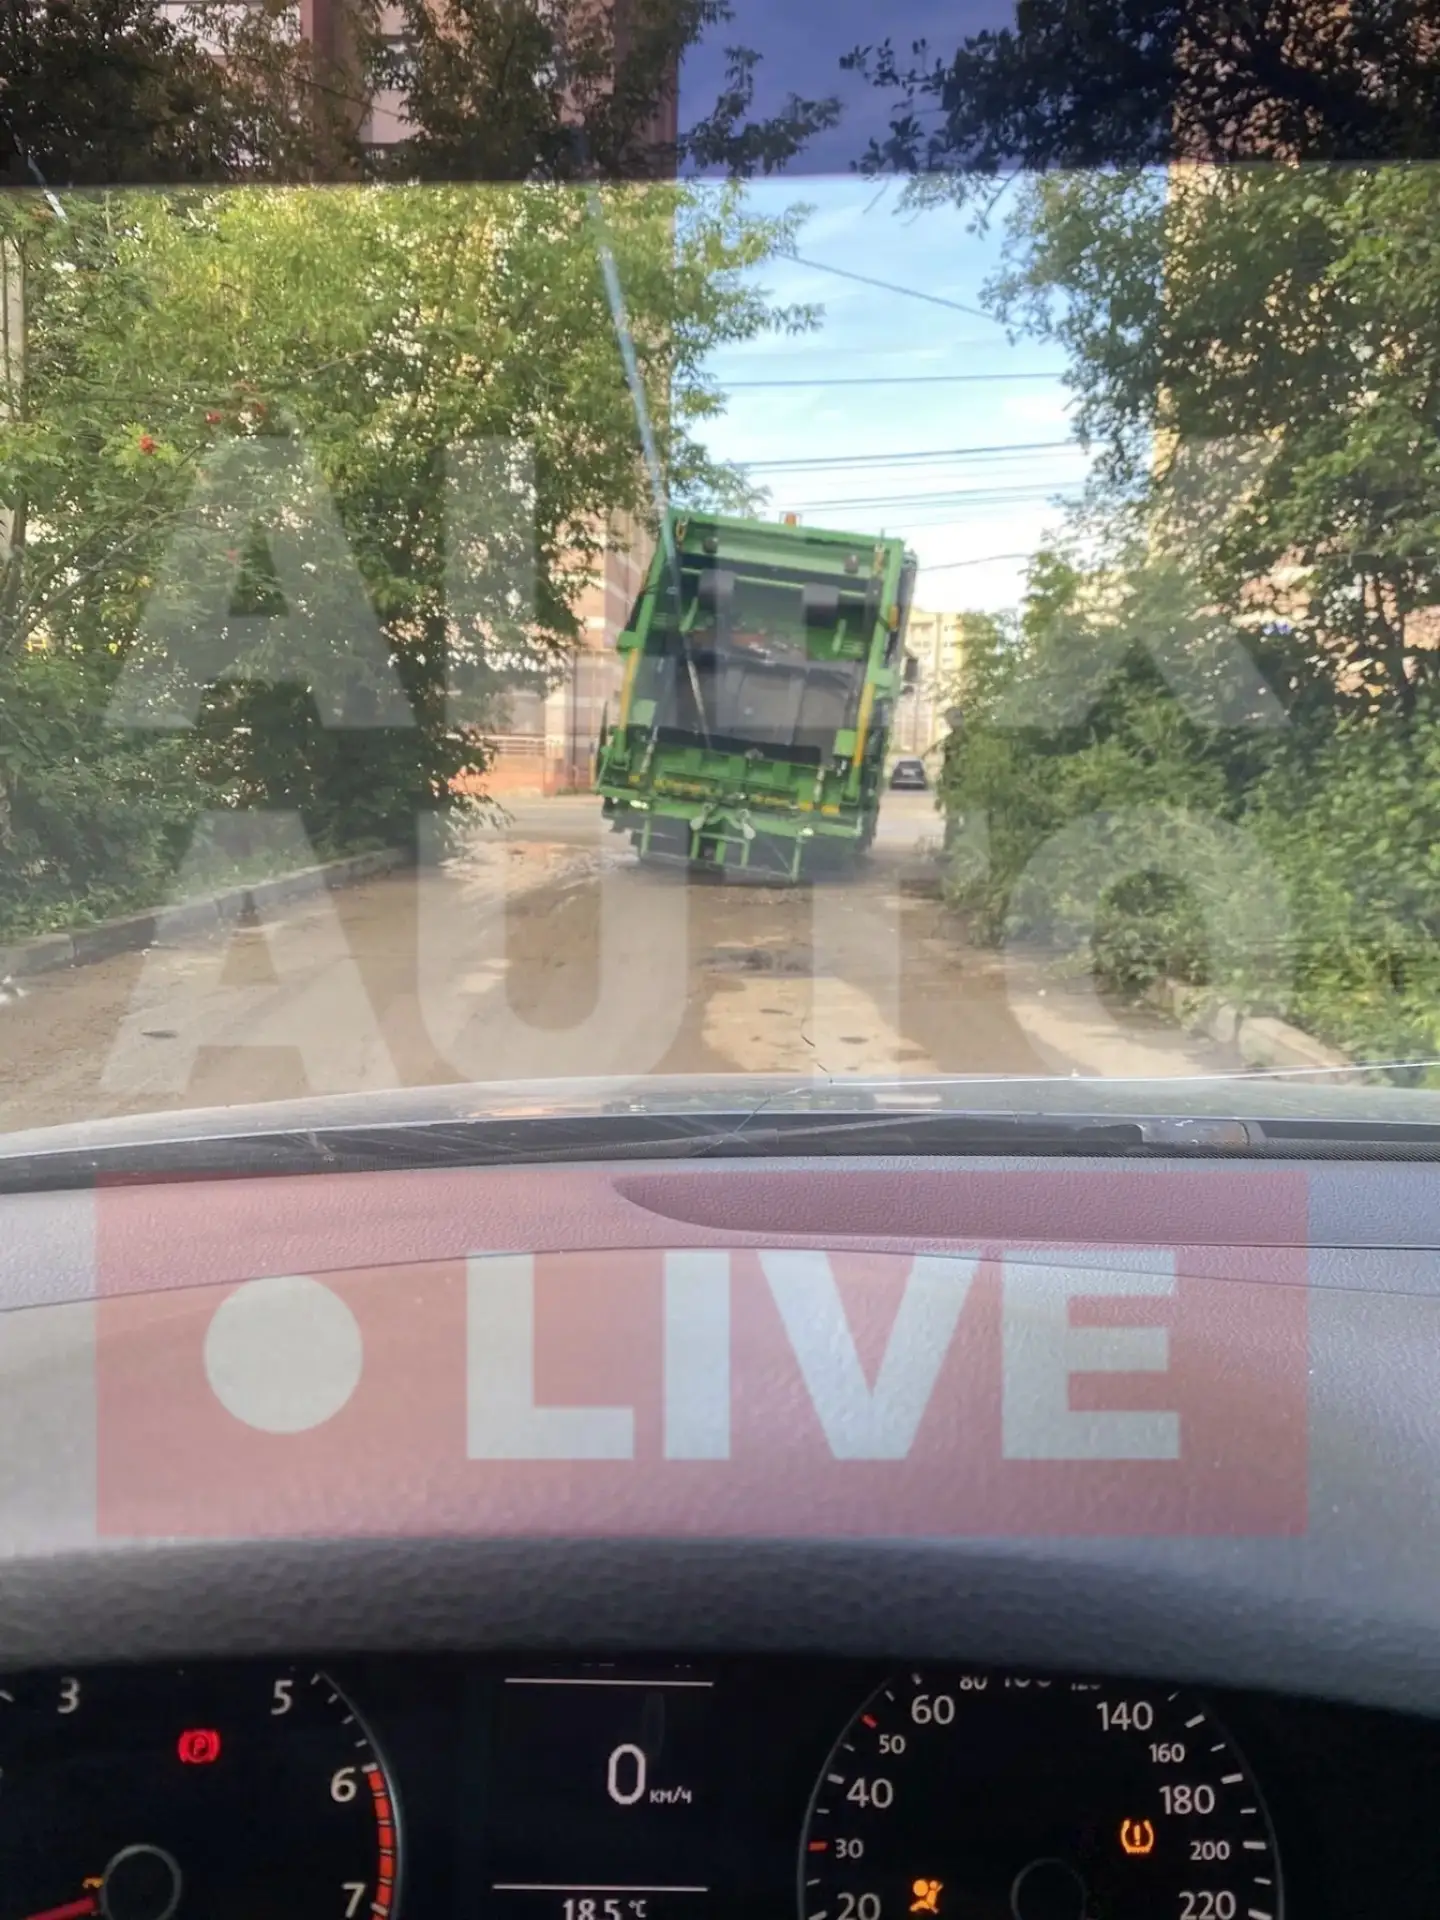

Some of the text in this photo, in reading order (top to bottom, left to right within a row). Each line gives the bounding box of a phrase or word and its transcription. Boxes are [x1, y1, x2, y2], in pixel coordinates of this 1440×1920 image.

[57, 1677, 79, 1714] 3
[270, 1679, 294, 1715] 5
[911, 1695, 955, 1725] 60
[1096, 1701, 1154, 1731] 140
[878, 1734, 906, 1754] 50
[1148, 1743, 1185, 1763] 160
[330, 1766, 357, 1803] 6
[608, 1743, 646, 1805] 0
[846, 1777, 893, 1809] 40
[1158, 1784, 1215, 1815] 180
[835, 1838, 864, 1859] 30
[1189, 1840, 1230, 1861] 200
[341, 1882, 366, 1918] 7
[562, 1899, 621, 1920] 185
[837, 1892, 881, 1920] 20
[1178, 1890, 1236, 1920] 220
